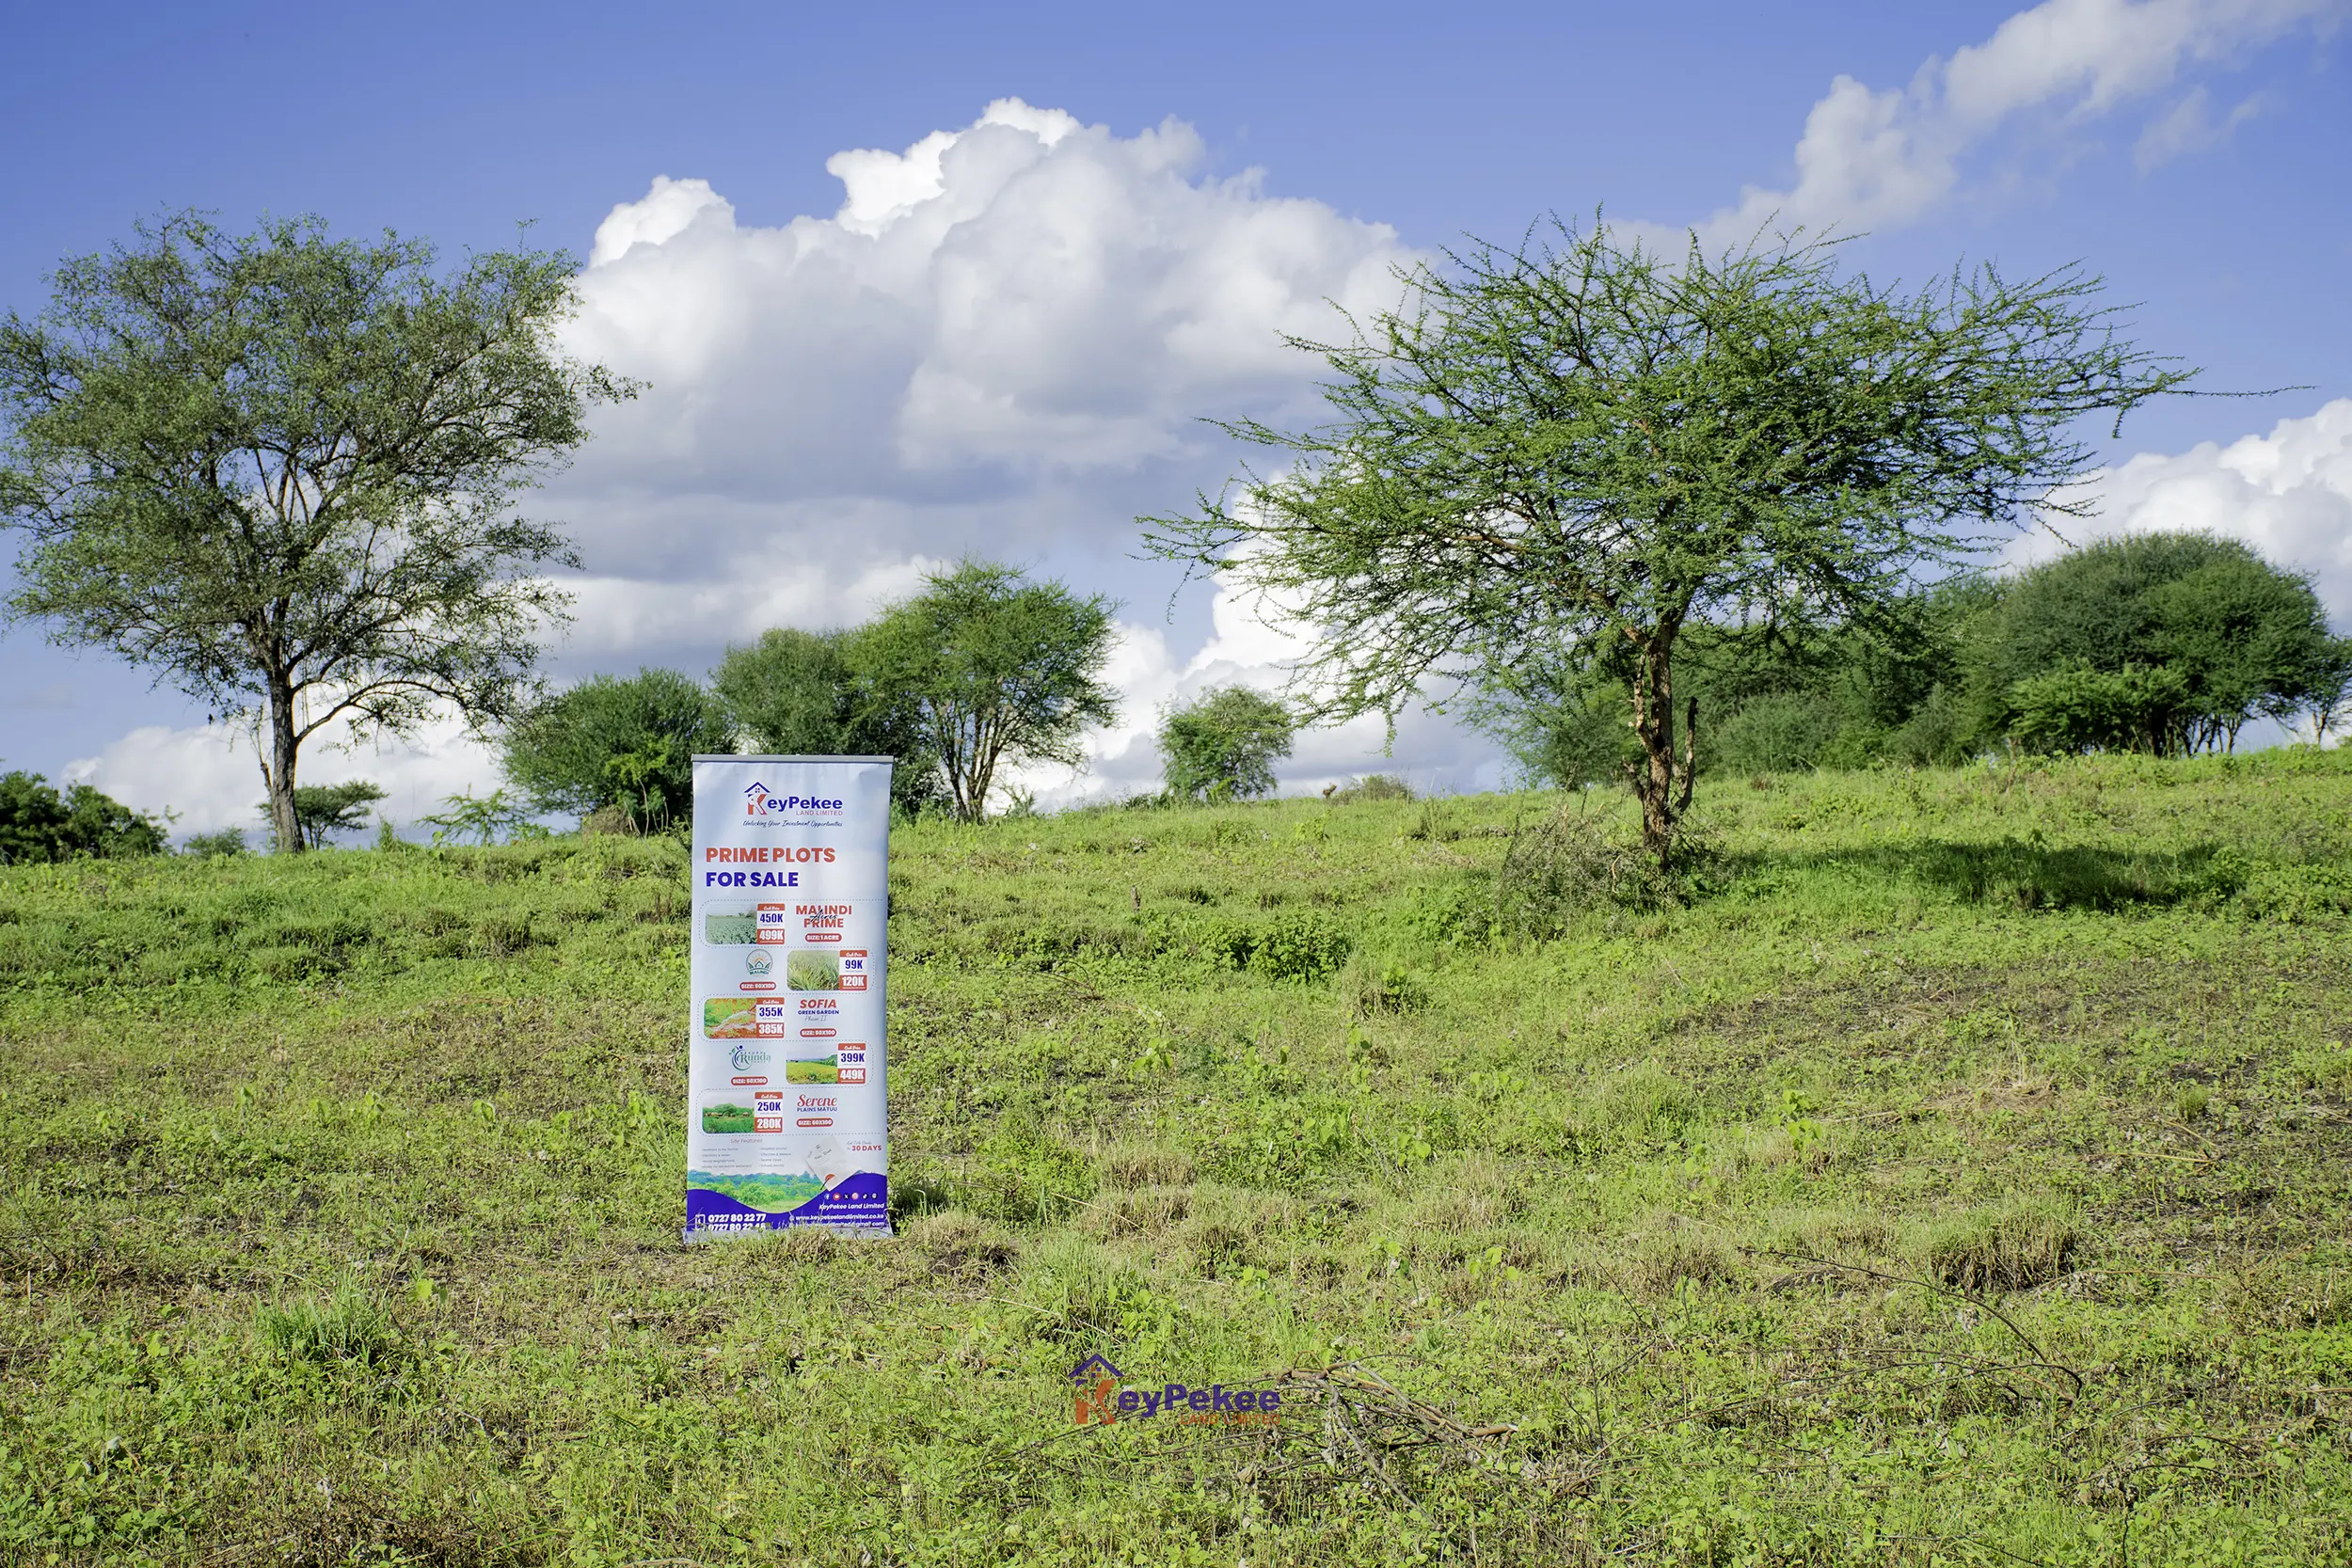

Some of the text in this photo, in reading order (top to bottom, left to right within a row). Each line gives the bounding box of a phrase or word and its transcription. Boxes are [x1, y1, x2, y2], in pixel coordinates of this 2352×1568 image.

[747, 793, 843, 816] KeyPekee
[742, 819, 767, 828] Unlocking
[707, 847, 835, 863] PRIME PLOTS
[707, 872, 799, 887] FOR SALE
[796, 905, 851, 915] MALINDI
[759, 913, 783, 923] 450K
[803, 918, 844, 928] PRIME
[759, 930, 783, 940] 499K
[845, 960, 863, 969] 99K
[842, 976, 864, 986] 120K
[800, 999, 837, 1009] SOFIA
[759, 1007, 783, 1017] 355K
[759, 1024, 784, 1034] 385K
[841, 1053, 865, 1062] 399K
[840, 1069, 865, 1080] 449K
[797, 1094, 838, 1107] Serene
[757, 1102, 781, 1112] 250K
[757, 1118, 781, 1129] 280K
[731, 1214, 743, 1222] 80
